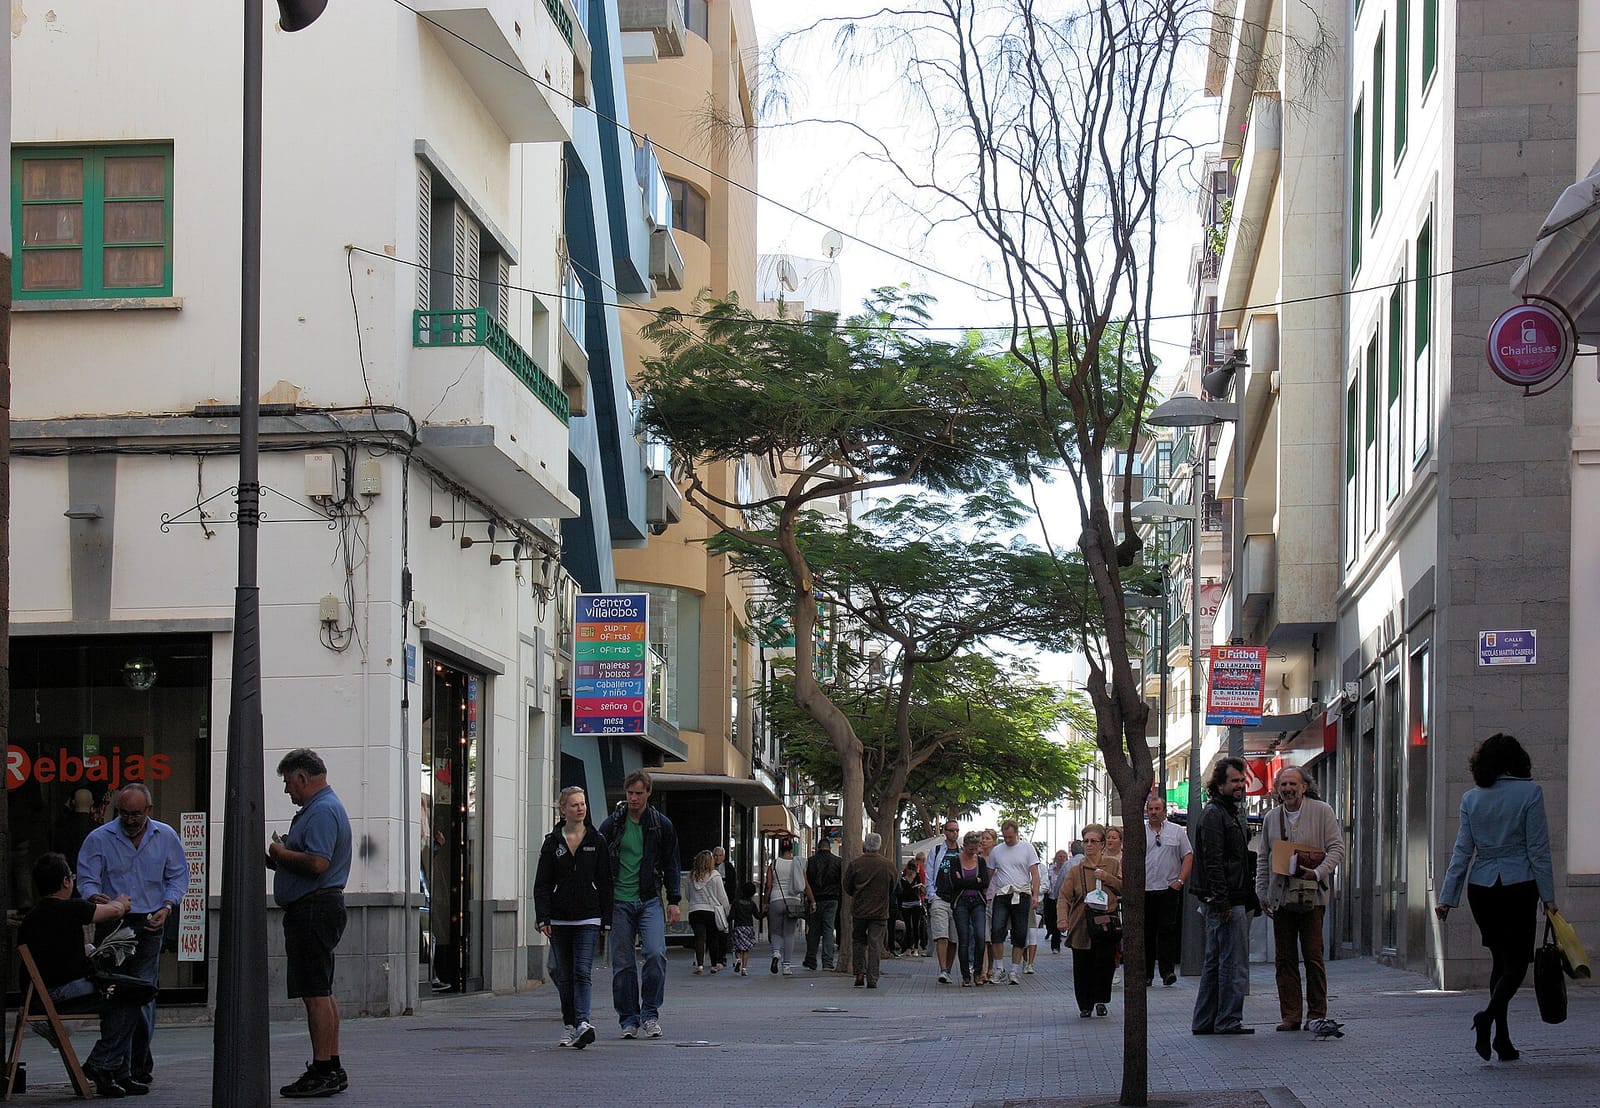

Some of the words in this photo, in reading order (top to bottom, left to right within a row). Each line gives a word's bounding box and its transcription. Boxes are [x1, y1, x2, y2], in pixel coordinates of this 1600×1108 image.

[1501, 345, 1557, 356] Charlies.es
[635, 624, 644, 639] 4
[634, 643, 643, 658] 3
[1227, 649, 1259, 659] Fútbol
[599, 671, 604, 679] y
[600, 662, 630, 670] maletas
[634, 662, 643, 677] 2
[596, 681, 634, 689] caballero
[634, 681, 643, 695] 1
[609, 688, 627, 697] niño
[600, 701, 628, 711] señora
[603, 717, 624, 725] mesa
[602, 726, 625, 734] sport
[7, 746, 172, 790] Rebajas
[183, 825, 199, 840] 19,95
[183, 898, 198, 914] 19,95
[181, 933, 197, 957] 14,95
